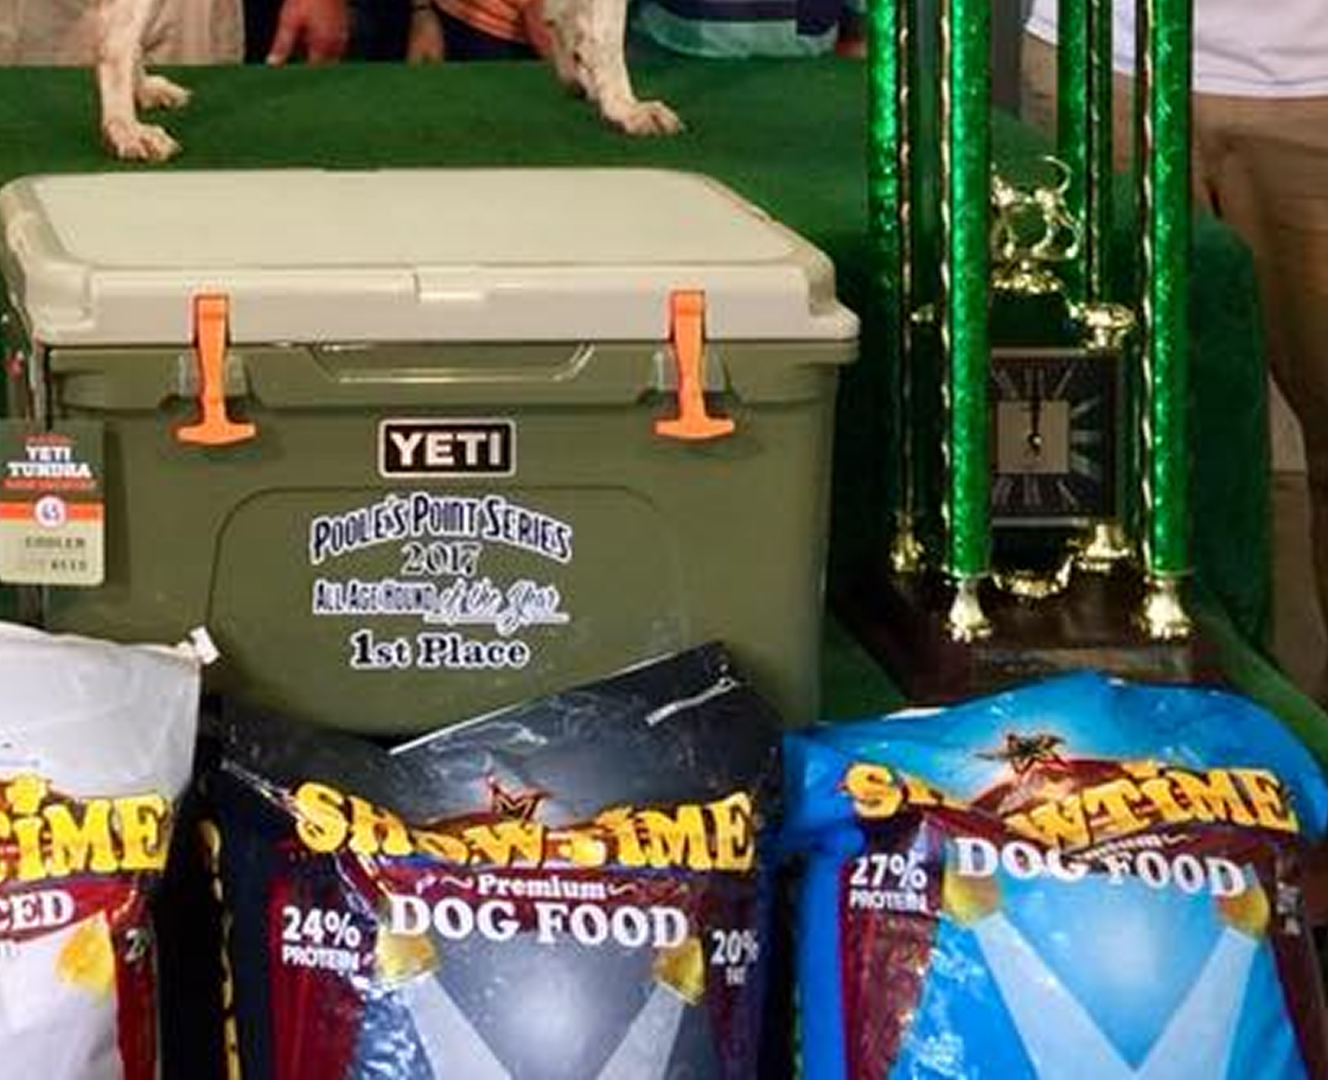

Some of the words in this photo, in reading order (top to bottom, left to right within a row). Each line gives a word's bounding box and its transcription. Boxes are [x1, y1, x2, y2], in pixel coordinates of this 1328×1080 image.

[25, 446, 71, 461] YETI
[389, 431, 501, 466] YETI
[484, 497, 569, 560] SERIES
[403, 543, 481, 575] 2017
[353, 631, 409, 667] 1st
[419, 634, 529, 667] Place
[850, 853, 928, 890] 27%
[954, 836, 1090, 882] DOG
[1099, 849, 1246, 898] FOOD
[478, 873, 608, 901] Premium
[281, 905, 361, 948] 24%
[388, 893, 520, 942] DOG
[535, 901, 688, 950] FOOD
[711, 928, 760, 965] 20%
